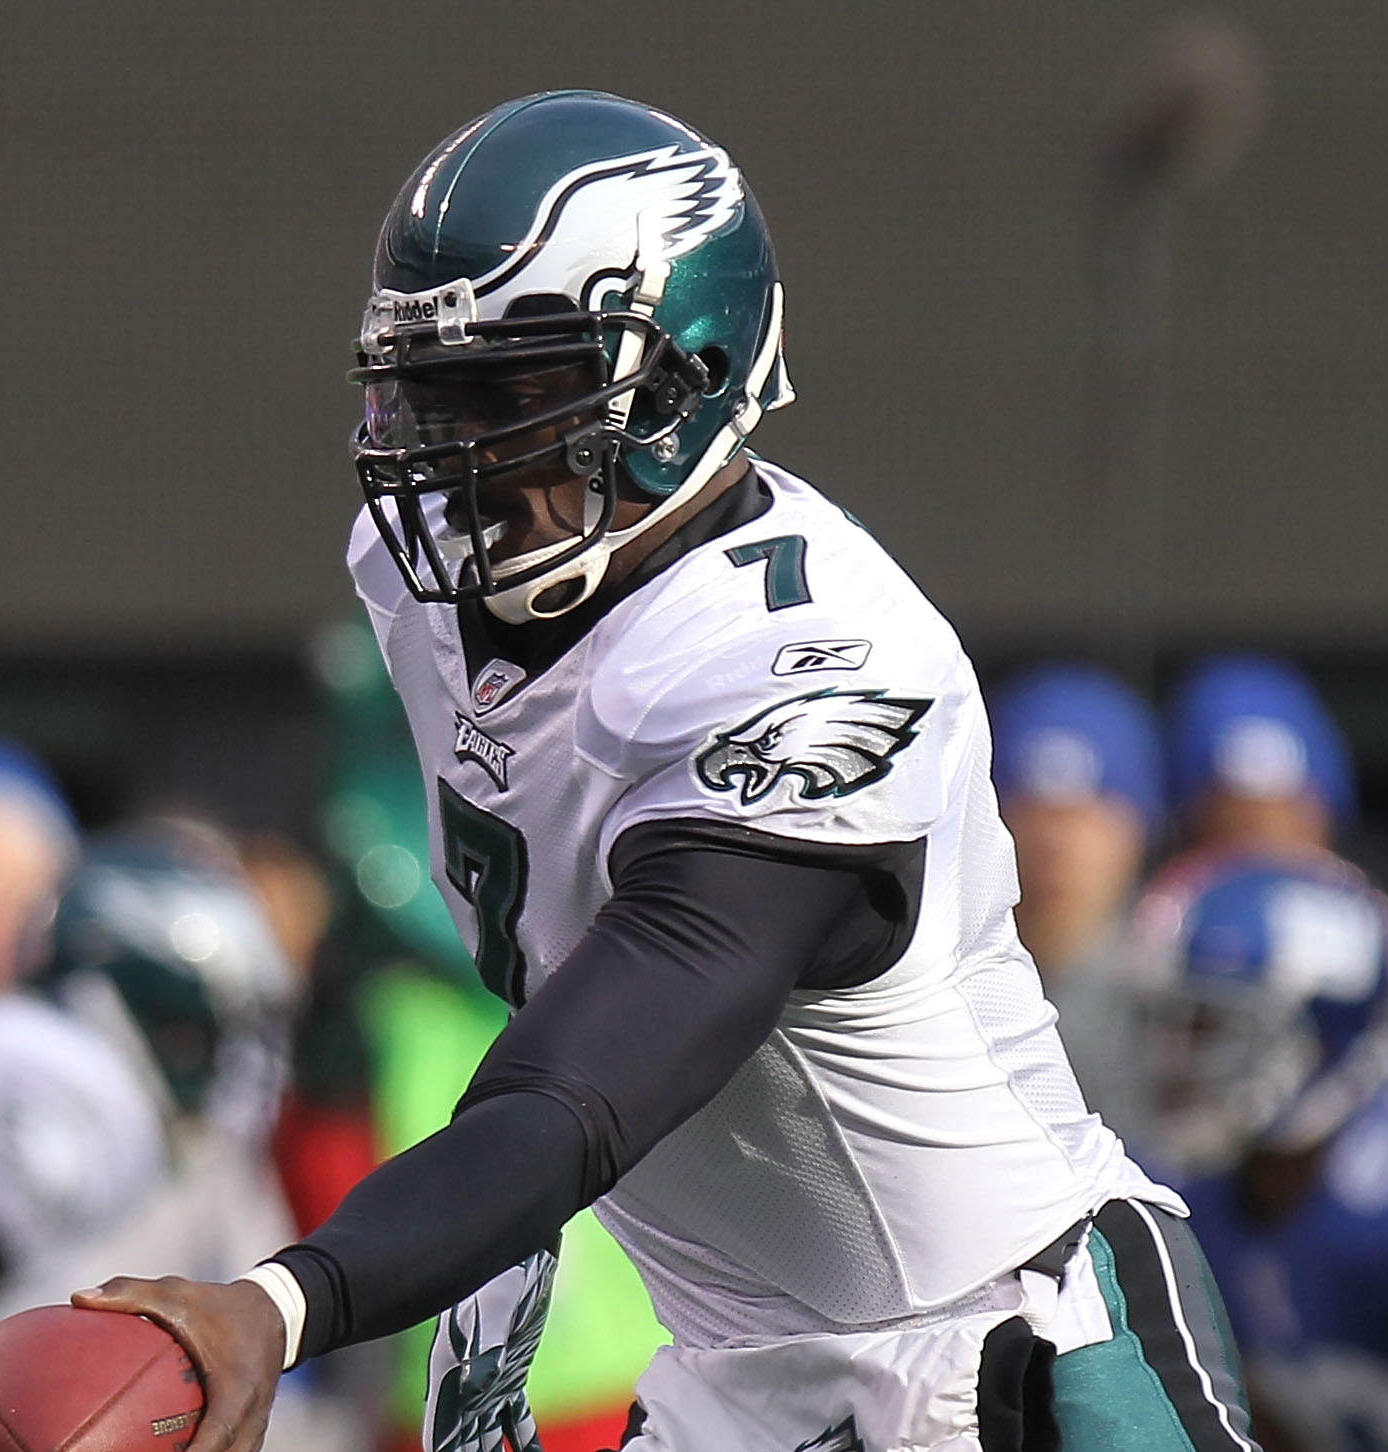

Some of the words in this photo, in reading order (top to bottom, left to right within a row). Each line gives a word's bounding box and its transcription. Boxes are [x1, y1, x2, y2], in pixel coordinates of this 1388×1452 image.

[393, 296, 438, 322] Riddel
[722, 534, 813, 612] 7
[437, 775, 530, 1012] 7
